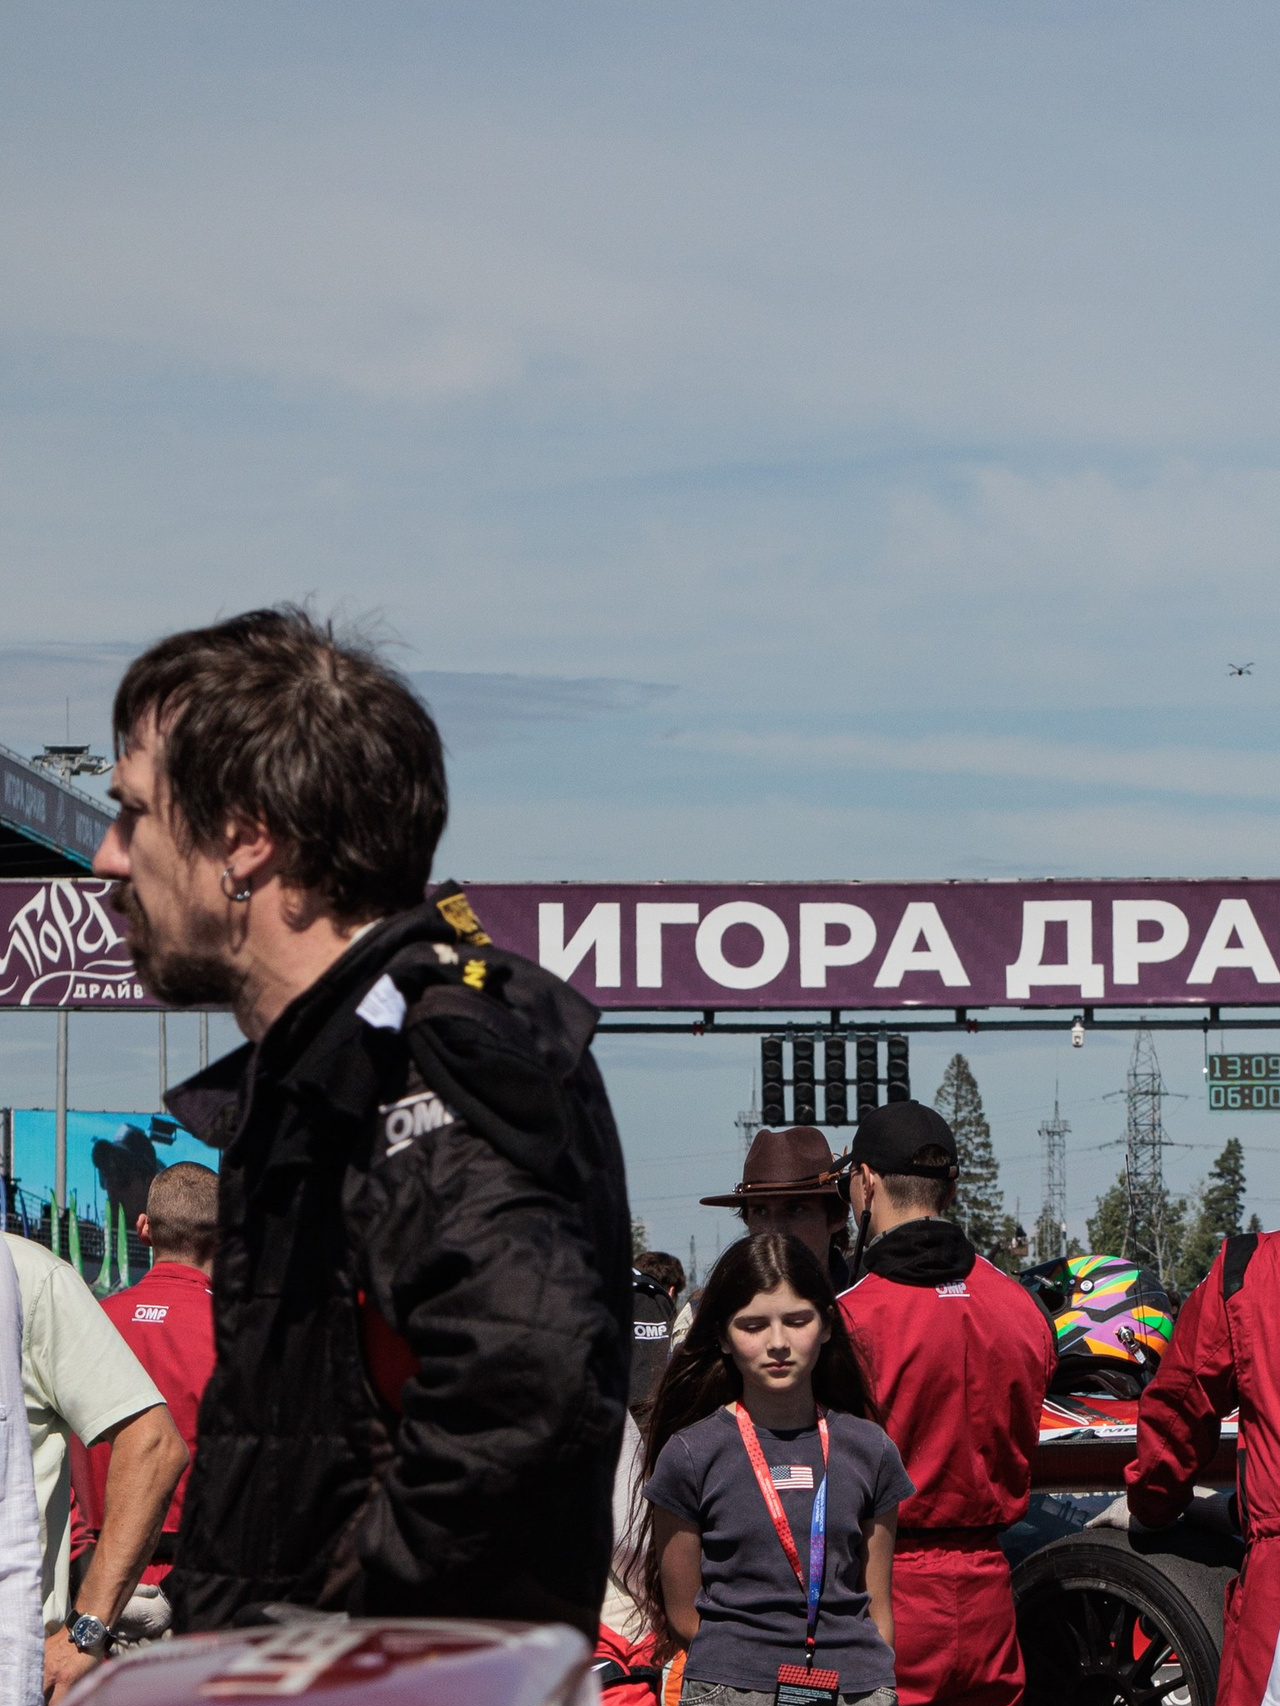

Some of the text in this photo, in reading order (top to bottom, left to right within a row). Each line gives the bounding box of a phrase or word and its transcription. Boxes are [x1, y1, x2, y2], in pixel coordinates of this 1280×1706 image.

[538, 901, 970, 990] ИГОРА
[73, 981, 144, 999] ДРАЙВ
[935, 1282, 967, 1295] OMP
[134, 1307, 167, 1321] OMP
[634, 1325, 667, 1338] OMP
